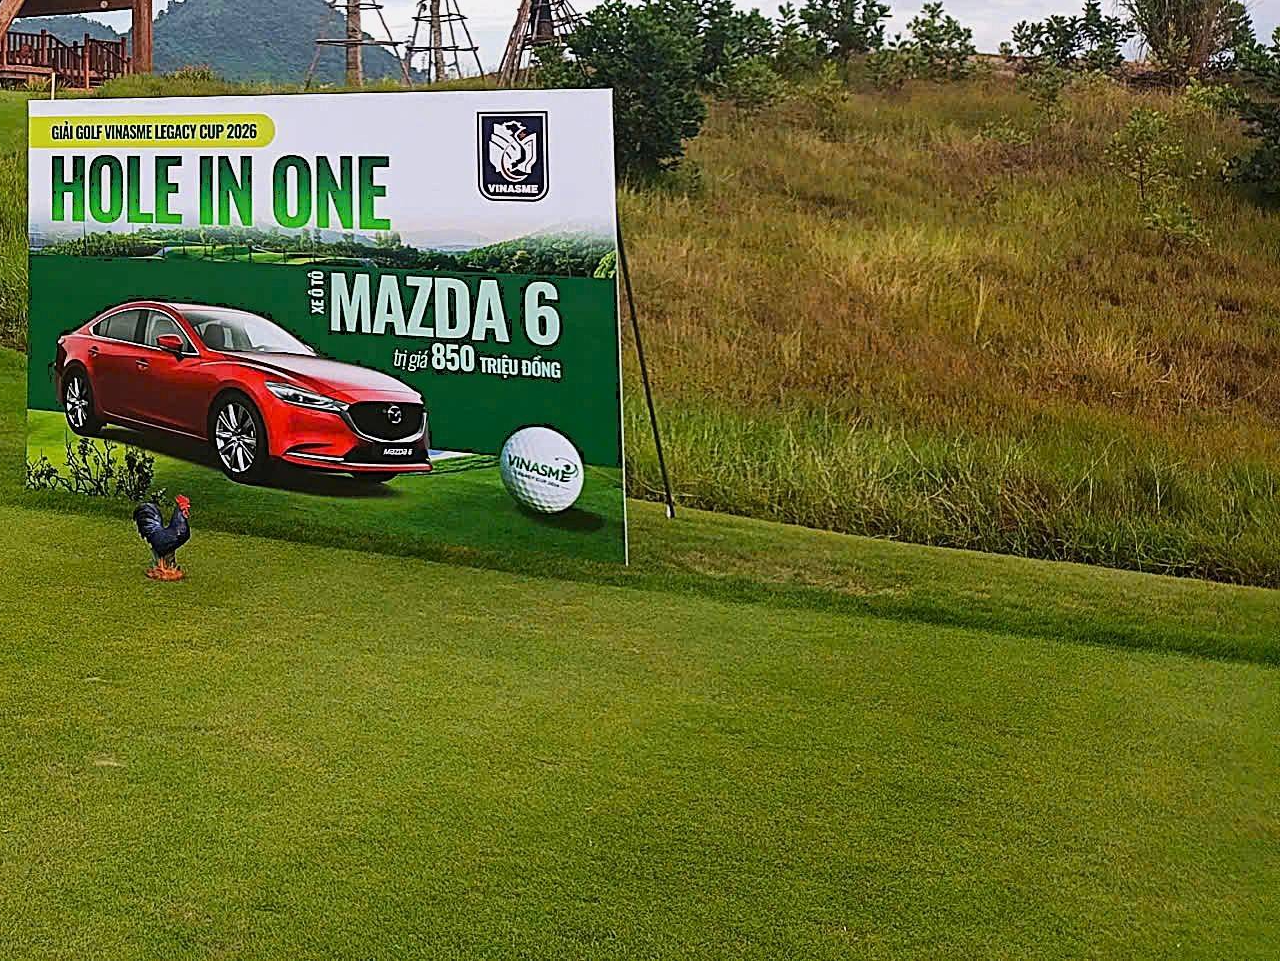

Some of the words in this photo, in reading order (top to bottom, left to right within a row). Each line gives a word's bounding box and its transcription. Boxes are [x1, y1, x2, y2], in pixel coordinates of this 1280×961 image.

[51, 120, 74, 140] GIẢI
[75, 124, 103, 140] GOLF
[104, 124, 153, 140] VINASME
[154, 124, 197, 140] LEGACY
[199, 123, 224, 140] CUP
[226, 123, 258, 139] 2026
[51, 155, 183, 224] HOLE
[199, 155, 253, 227] IN
[272, 154, 391, 231] ONE
[487, 183, 539, 194] VINASME
[307, 270, 325, 287] TÔ
[307, 288, 325, 298] Ô
[310, 298, 325, 315] XE
[330, 271, 510, 343] MAZDA
[524, 281, 561, 346] 6
[393, 348, 408, 370] trị
[409, 348, 430, 372] giá
[431, 342, 475, 372] 850
[479, 354, 518, 379] TRIỆU
[520, 355, 562, 379] ĐỒNG
[507, 453, 572, 483] VINASME
